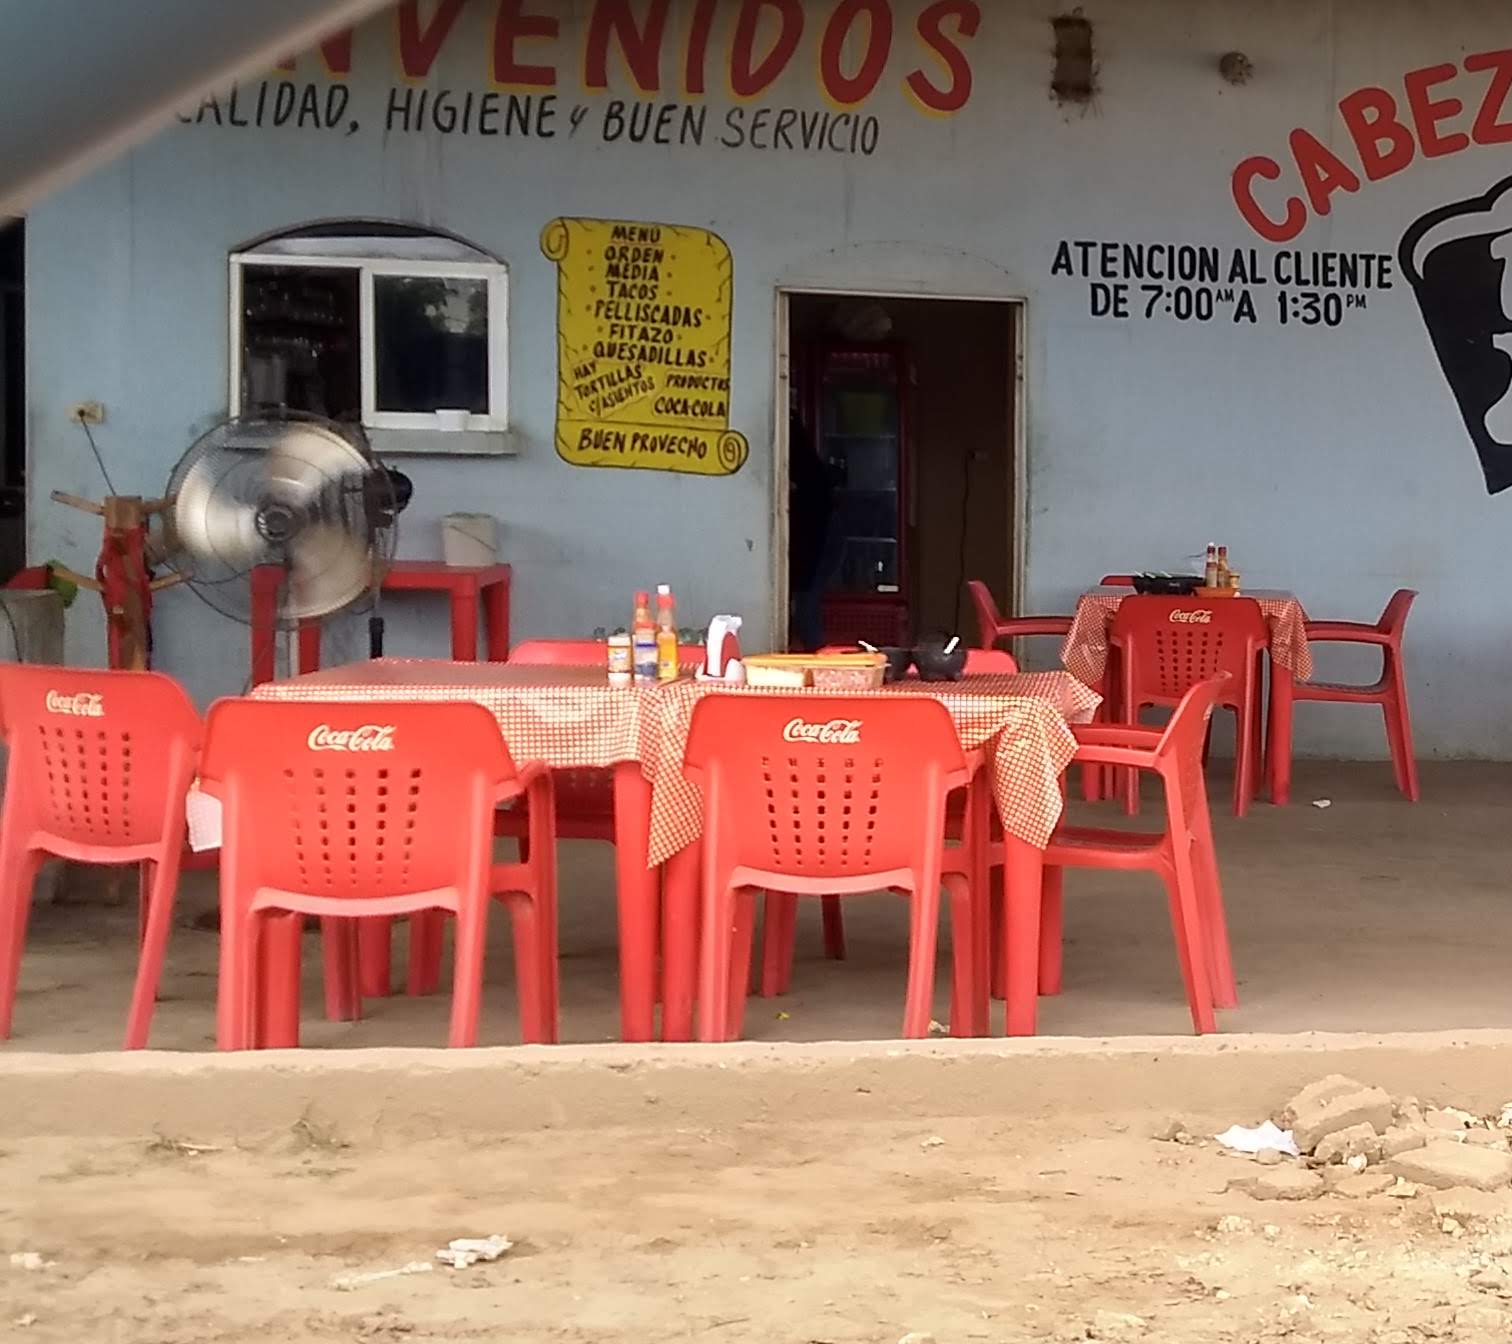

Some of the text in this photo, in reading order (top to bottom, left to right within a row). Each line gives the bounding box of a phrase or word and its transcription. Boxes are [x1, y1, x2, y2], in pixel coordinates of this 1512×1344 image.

[174, 80, 360, 136] ALIDAD,
[386, 87, 557, 137] HIGIENE
[602, 99, 706, 146] BUEN
[720, 107, 880, 156] SERVICIO
[610, 225, 661, 243] MENU
[604, 245, 665, 264] ORDEN
[1050, 240, 1394, 290] ATENCION AL CLIENTE
[604, 263, 660, 281] MEDIA
[606, 280, 659, 301] TACOS
[1090, 282, 1129, 318] DE
[1233, 290, 1257, 324] A
[594, 300, 703, 328] PELLISCADAS
[608, 323, 674, 344] FITAZO
[593, 340, 707, 368] QUESADILLAS
[574, 360, 597, 380] HAY
[574, 364, 643, 400] TORTILLAS
[578, 427, 708, 460] BUEN PROVECHO
